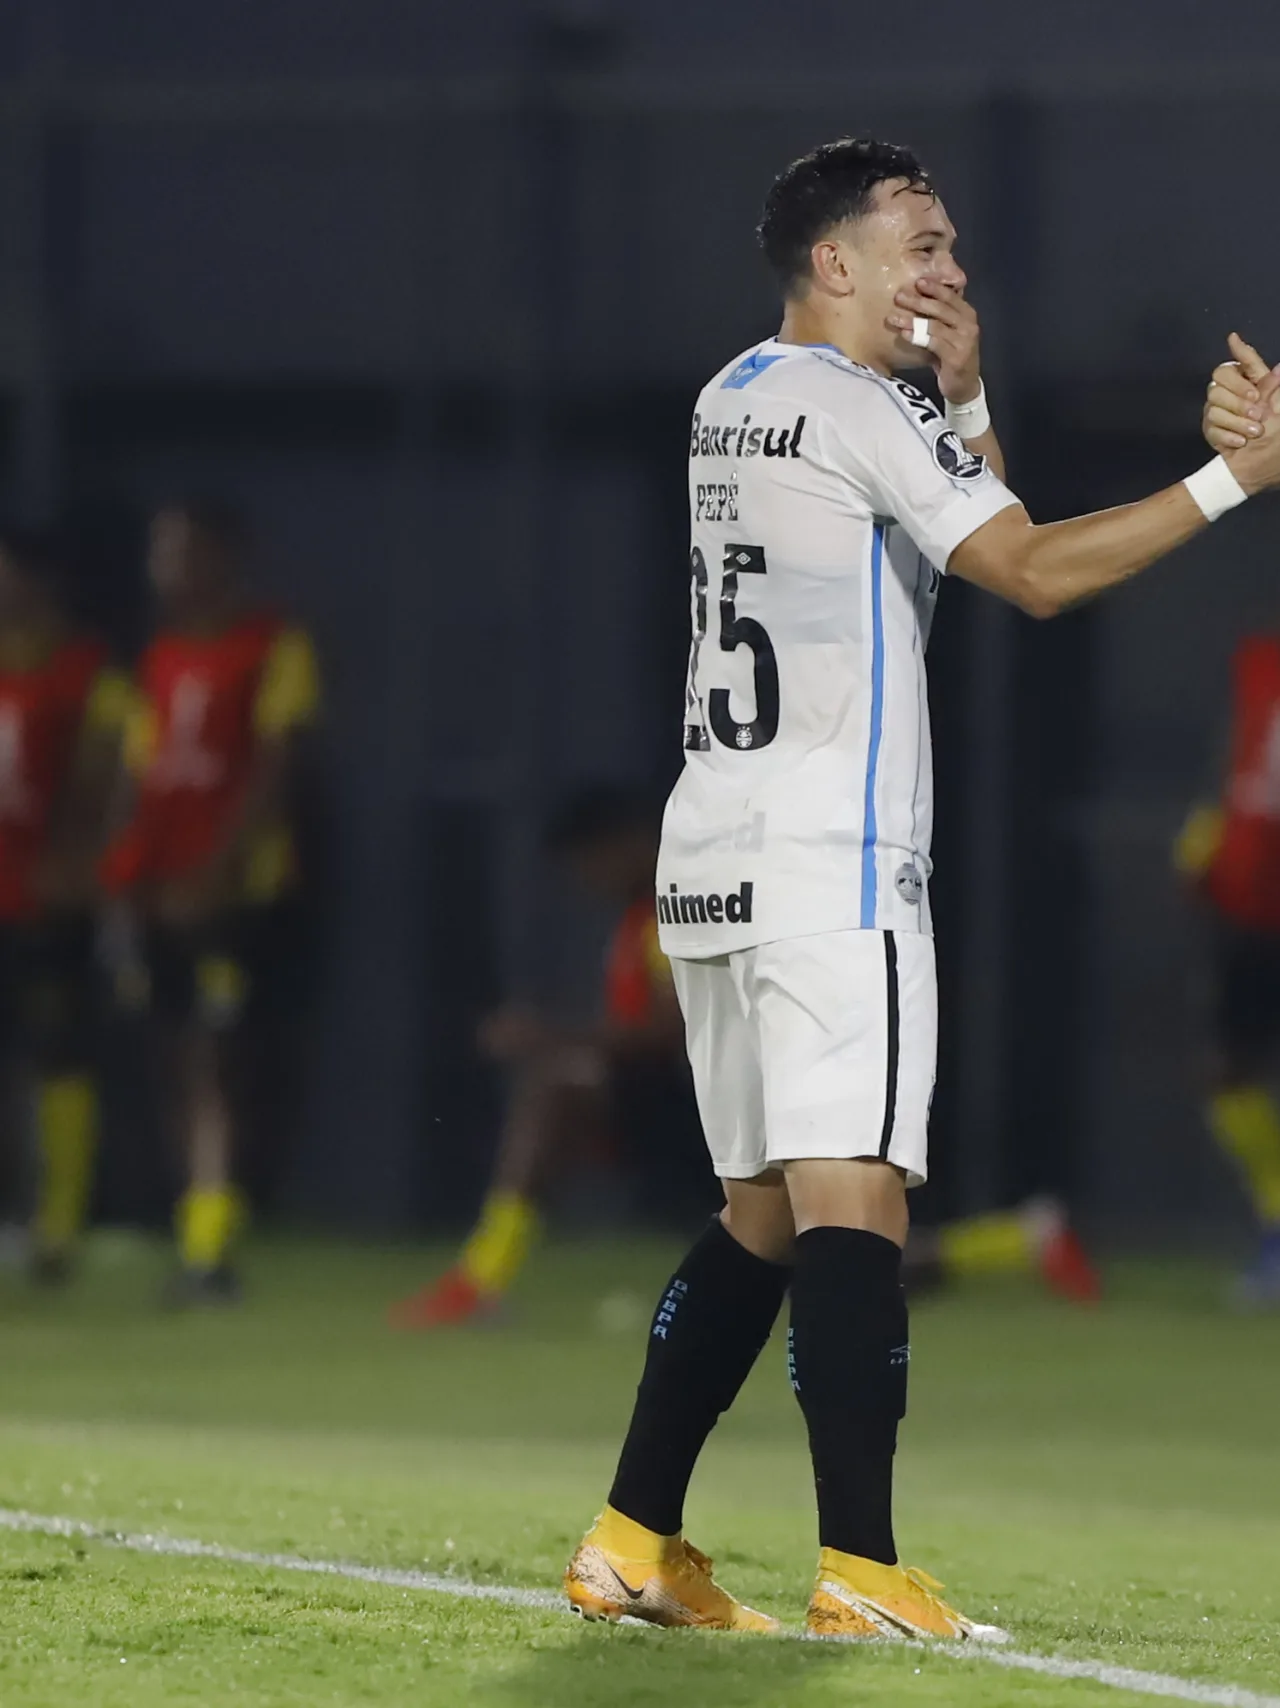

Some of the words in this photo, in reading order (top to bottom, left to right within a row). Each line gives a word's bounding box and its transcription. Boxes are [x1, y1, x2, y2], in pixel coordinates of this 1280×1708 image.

[691, 413, 806, 458] Banrisul
[696, 470, 738, 522] PEPÉ
[657, 881, 754, 924] nimed
